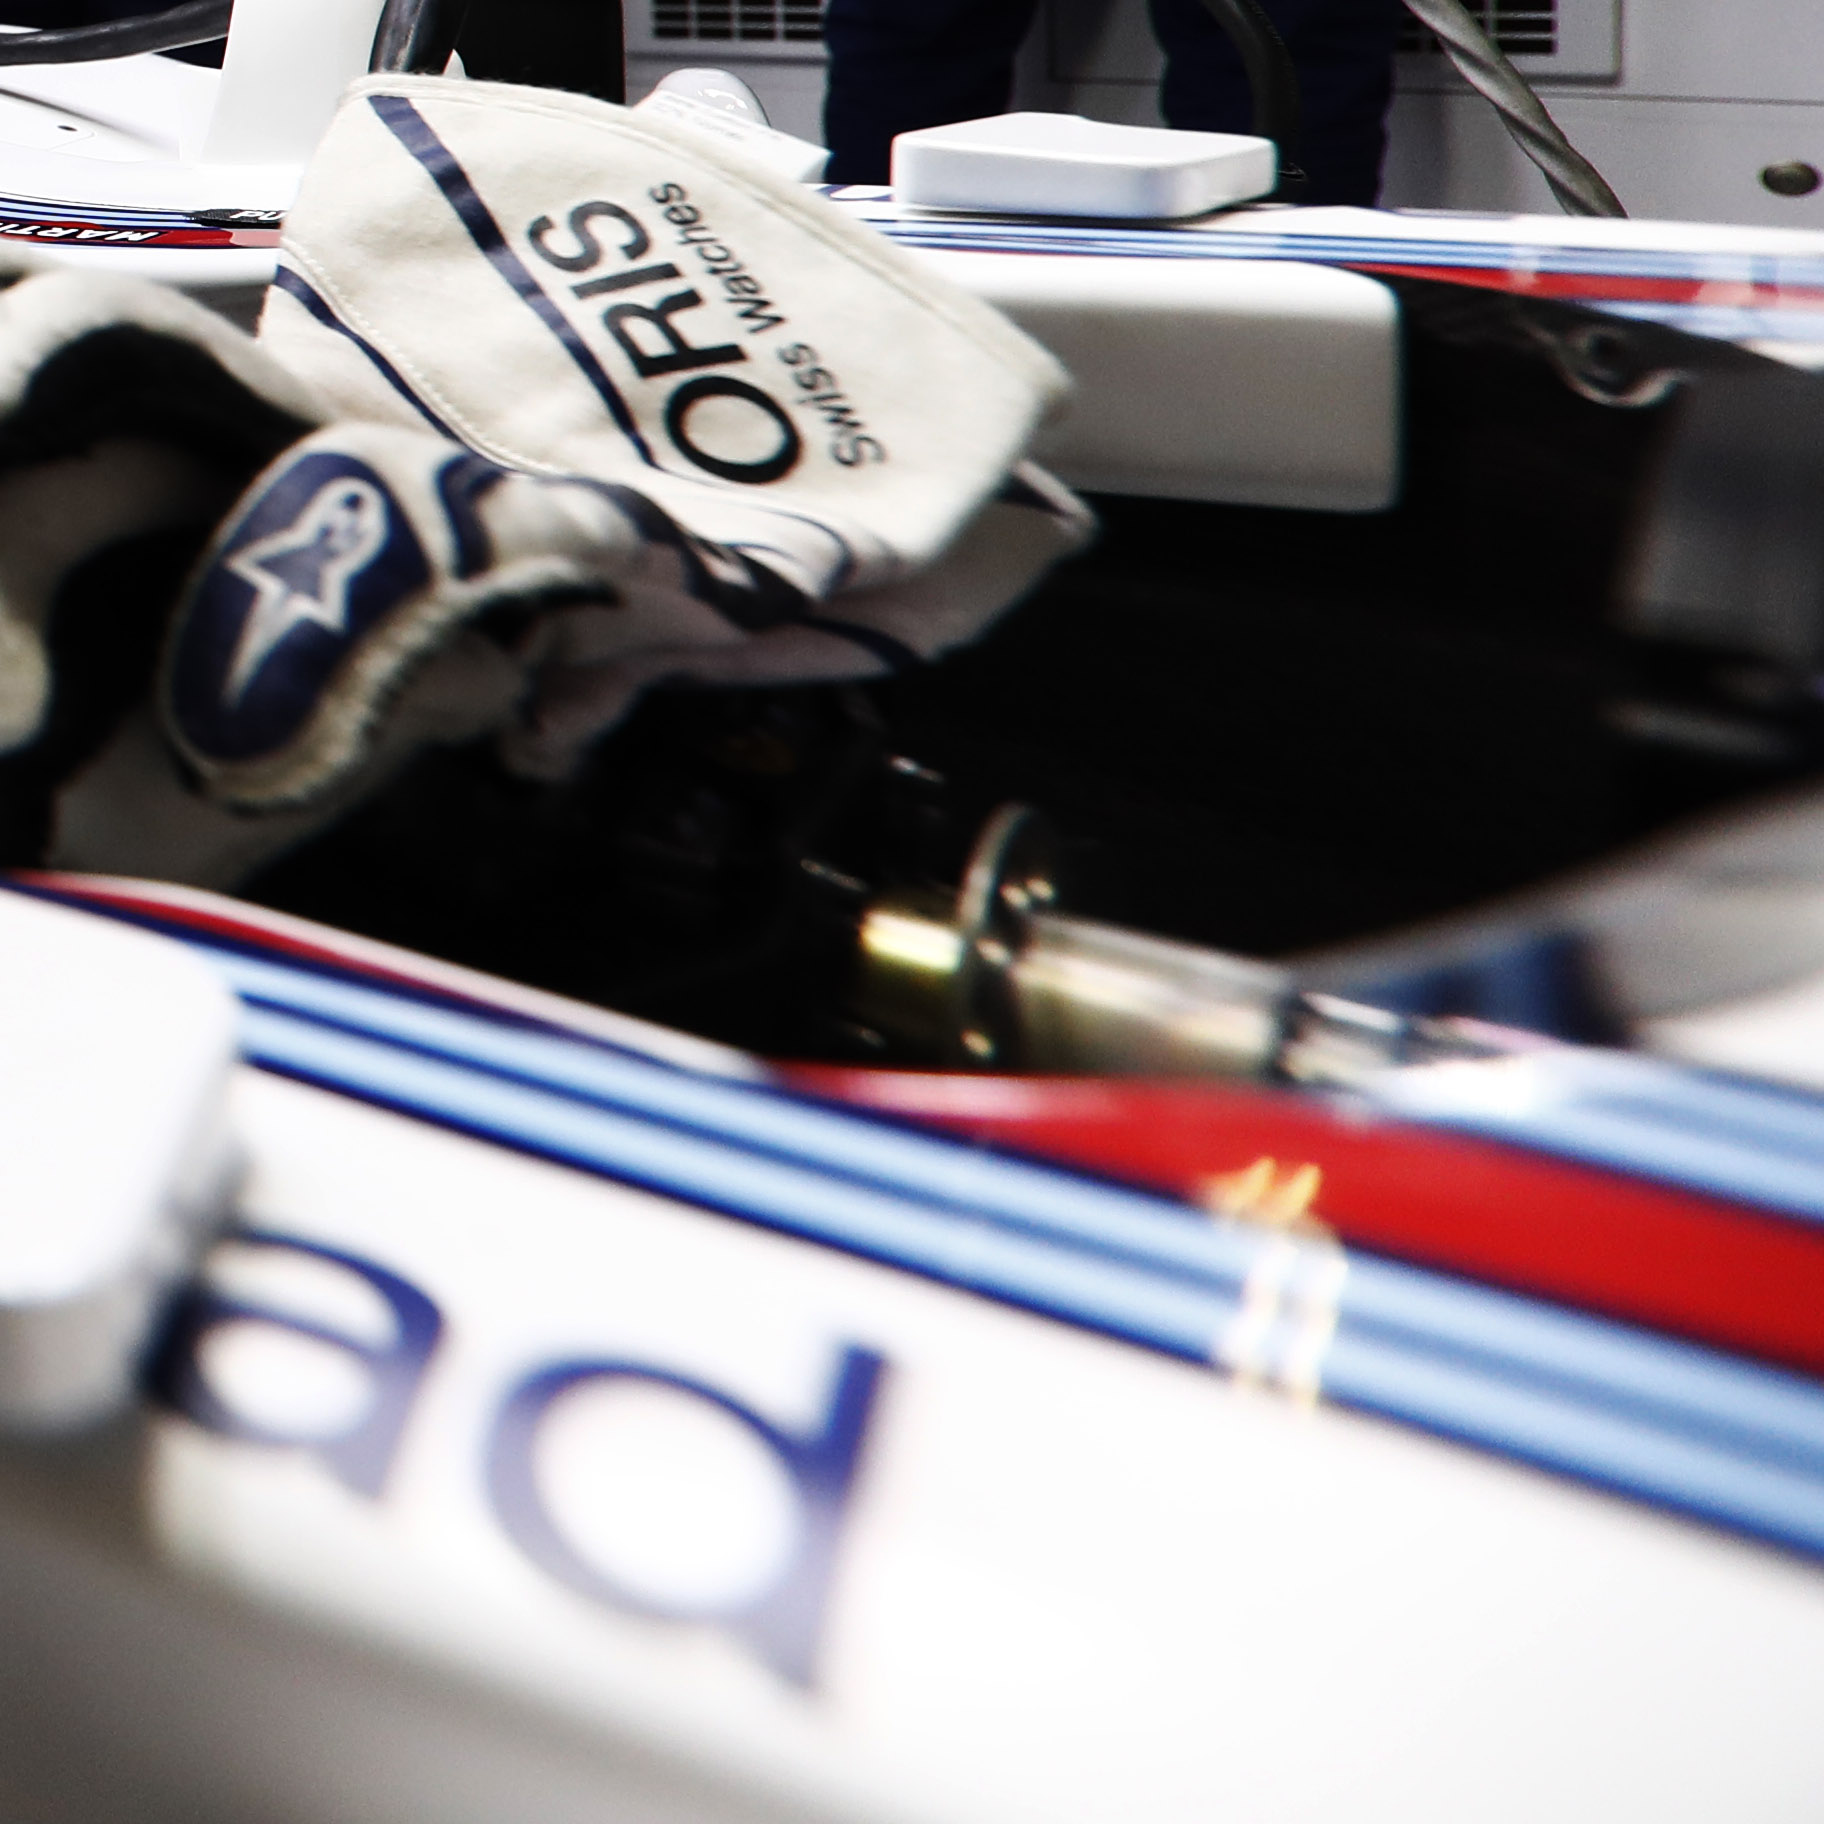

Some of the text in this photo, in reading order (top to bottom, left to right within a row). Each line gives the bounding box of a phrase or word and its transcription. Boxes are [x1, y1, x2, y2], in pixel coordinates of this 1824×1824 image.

[650, 181, 789, 336] Watches
[526, 200, 804, 485] ORIS
[778, 342, 888, 468] Swiss
